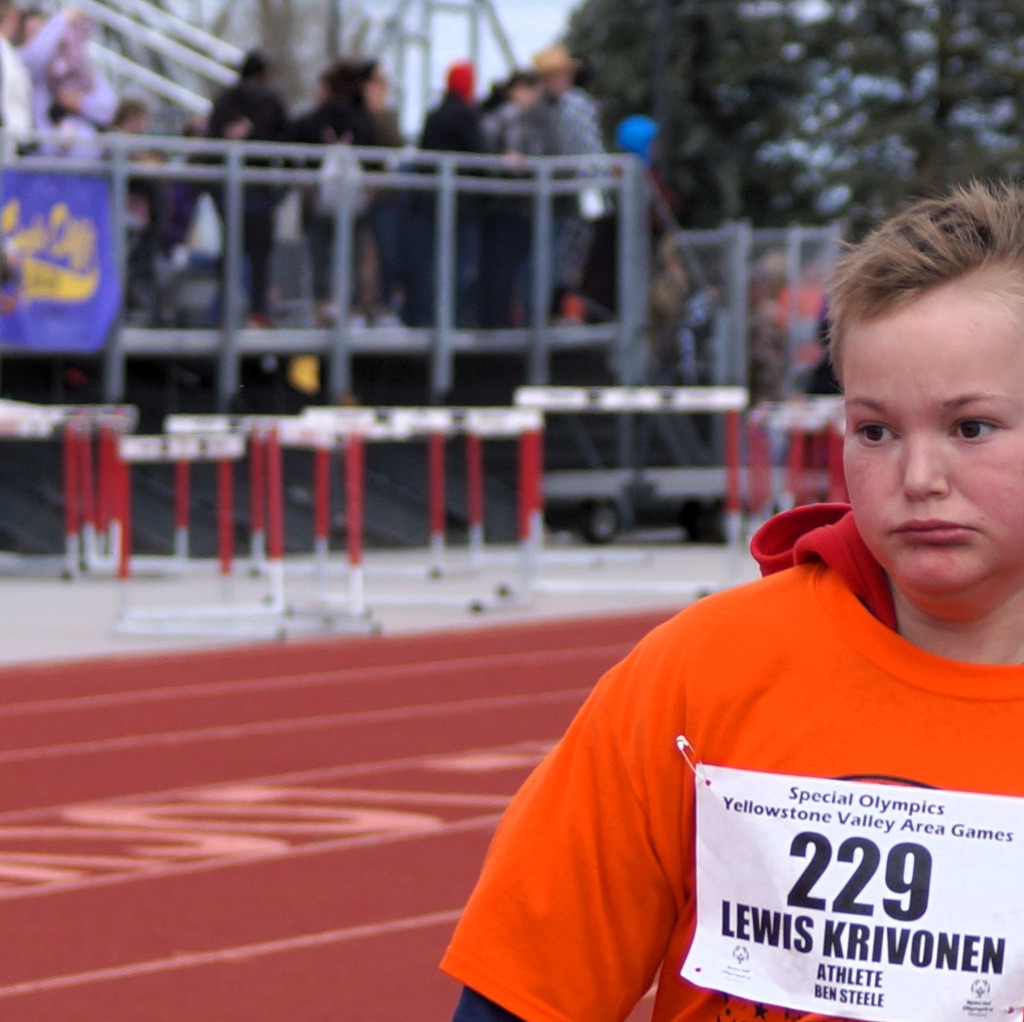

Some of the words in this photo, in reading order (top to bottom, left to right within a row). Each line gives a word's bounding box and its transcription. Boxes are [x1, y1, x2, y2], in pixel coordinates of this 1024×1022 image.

[724, 797, 831, 822] Yellowstone
[838, 812, 894, 833] Valley
[901, 819, 944, 835] Area
[952, 824, 1013, 841] Games
[789, 787, 853, 805] Special
[859, 795, 944, 816] Olympics
[787, 832, 932, 922] 229
[722, 900, 814, 954] LEWIS
[823, 920, 1005, 974] KRIVONEN
[817, 963, 882, 988] ATHLETE
[815, 984, 836, 1001] BEN
[840, 989, 884, 1007] STEELE
